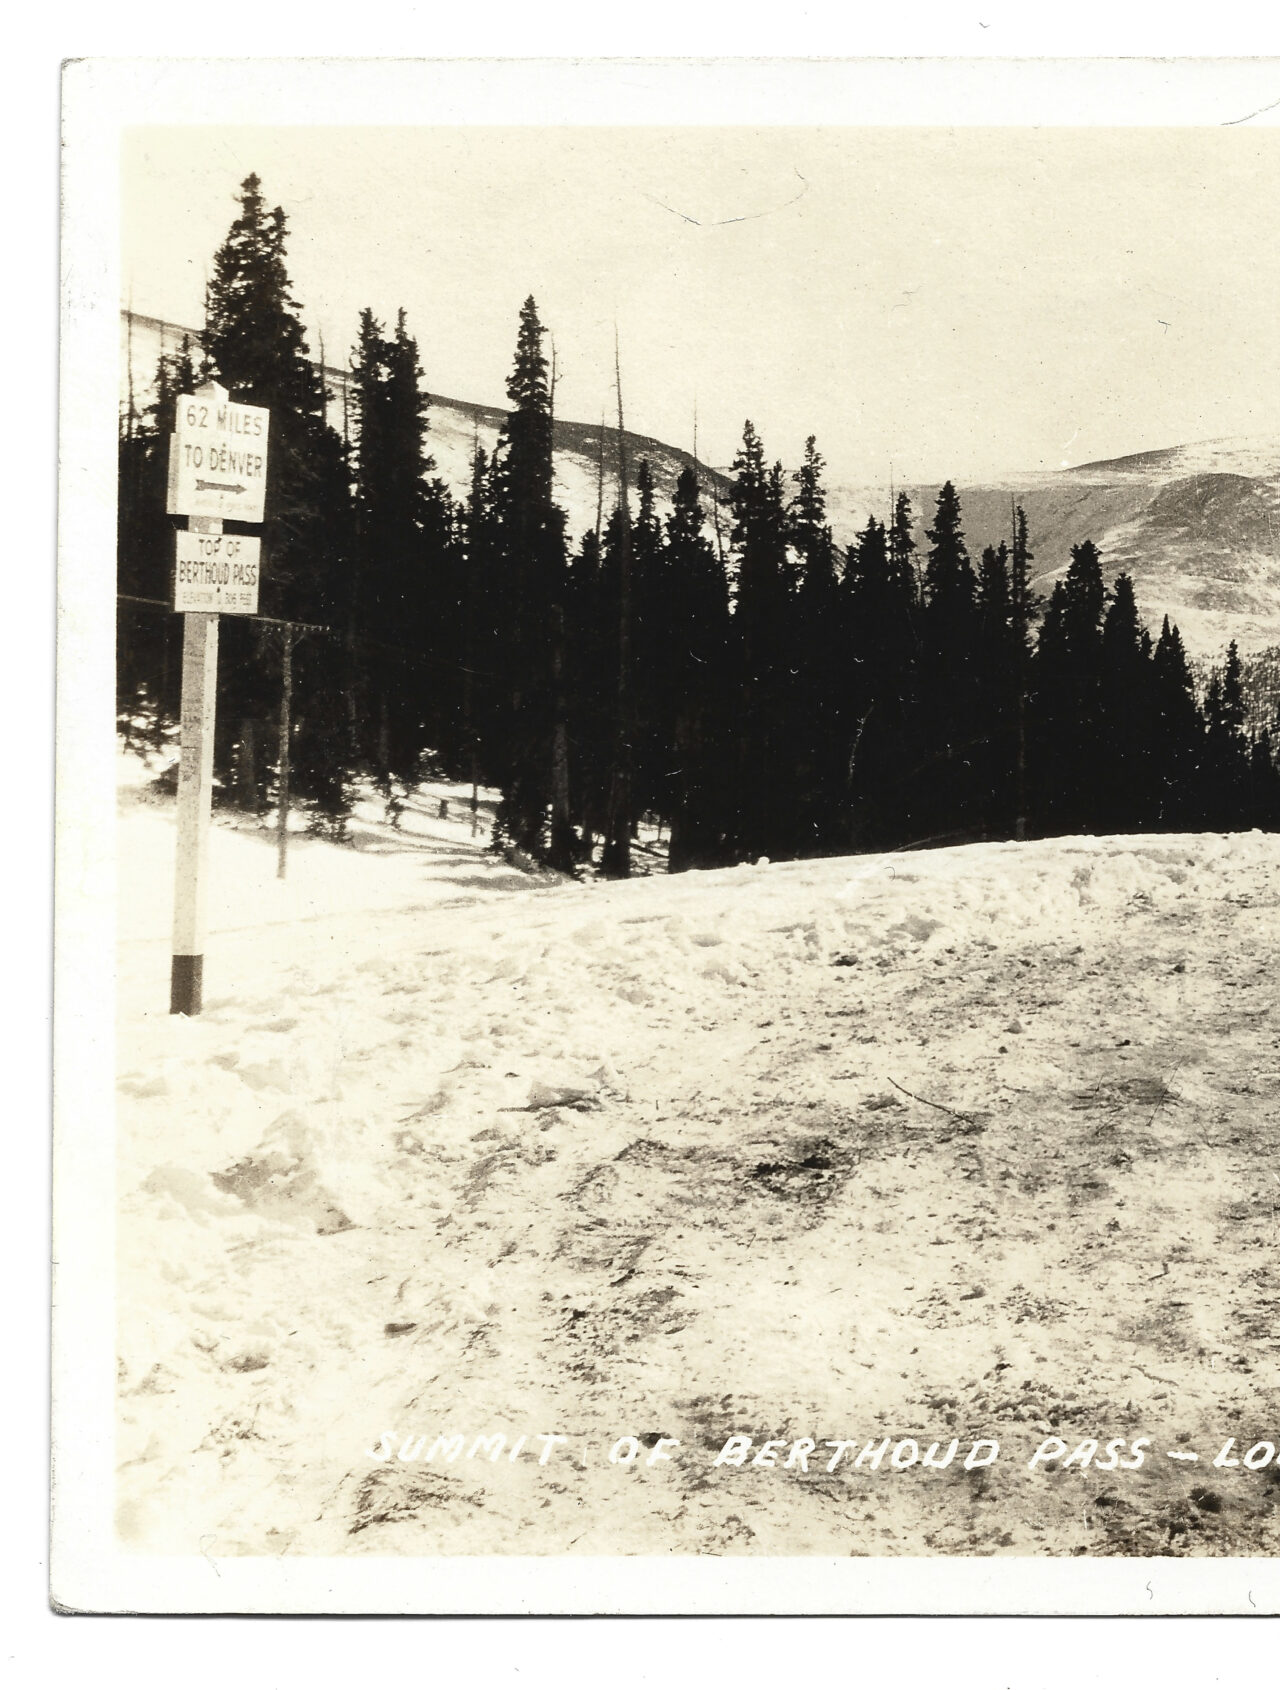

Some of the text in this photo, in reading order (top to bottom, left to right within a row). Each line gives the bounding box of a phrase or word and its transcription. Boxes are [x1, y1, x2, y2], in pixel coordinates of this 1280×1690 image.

[187, 405, 262, 436] 62 MILES
[185, 444, 262, 477] TO DENVER
[199, 538, 241, 558] TOP OF
[180, 561, 257, 586] BERTHOUD PASS
